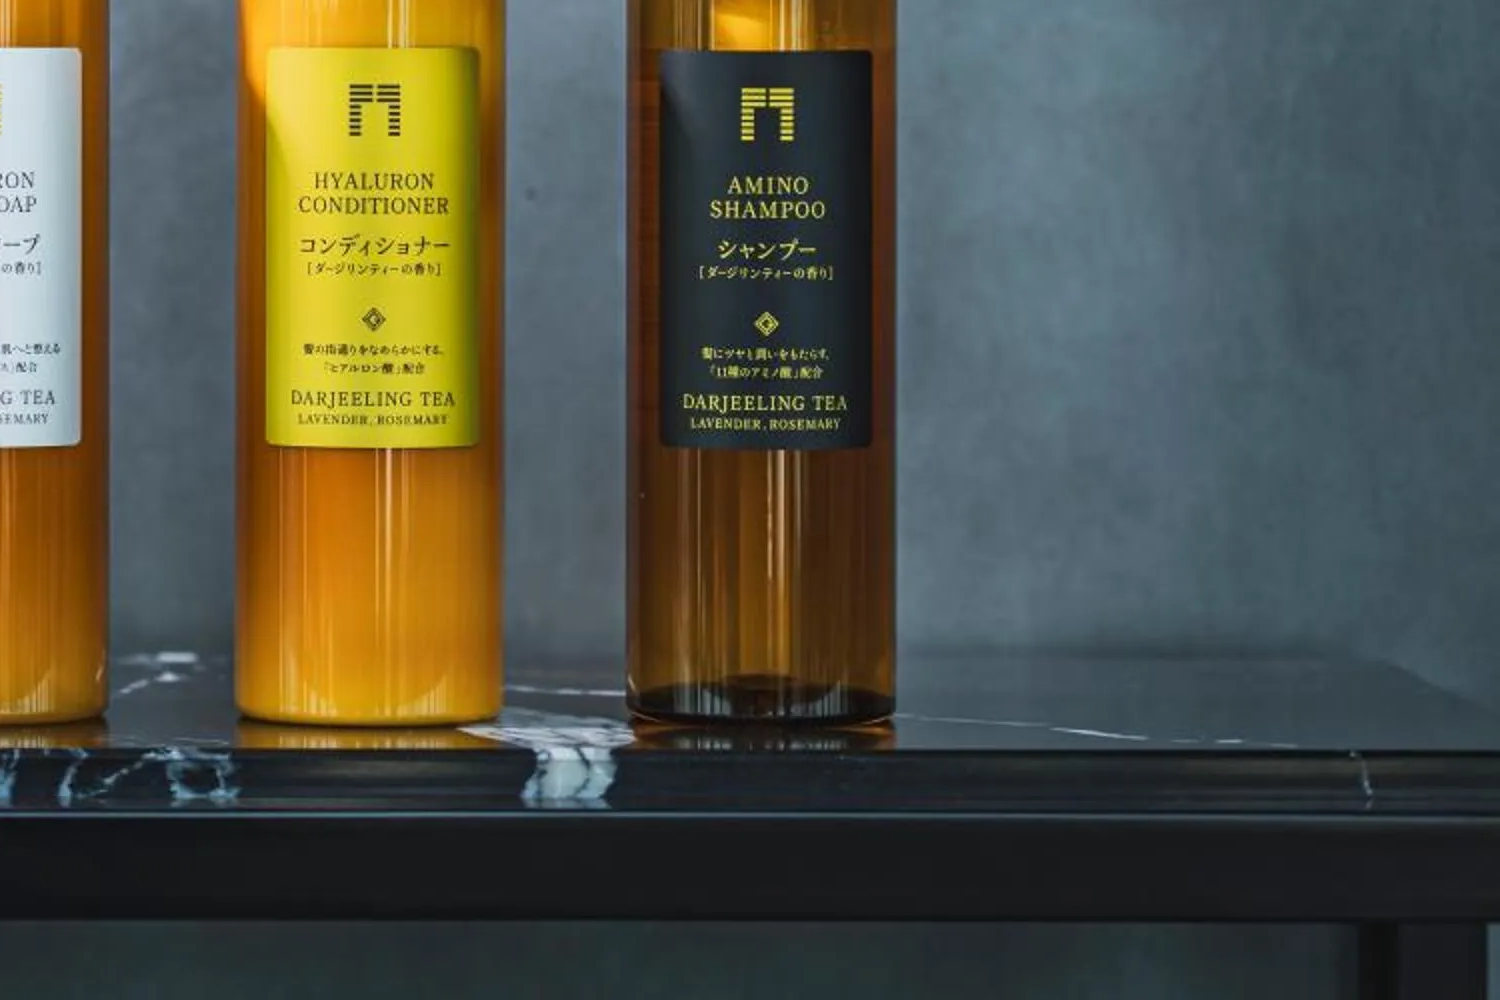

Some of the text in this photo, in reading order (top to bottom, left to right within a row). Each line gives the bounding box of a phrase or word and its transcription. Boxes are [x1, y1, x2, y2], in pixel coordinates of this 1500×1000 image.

[314, 172, 434, 190] HYALURON
[727, 176, 810, 195] AMINO
[299, 196, 450, 214] CONDITIONER
[709, 200, 826, 219] SHAMPOO
[300, 233, 451, 256] コンディショナー
[717, 238, 817, 261] シャンプー
[20, 389, 57, 405] TEA
[292, 389, 456, 409] DARJEELING TEA
[683, 393, 848, 414] DARJEELING TEA
[377, 414, 449, 426] ROSEMARY
[769, 418, 842, 430] ROSEMARY
